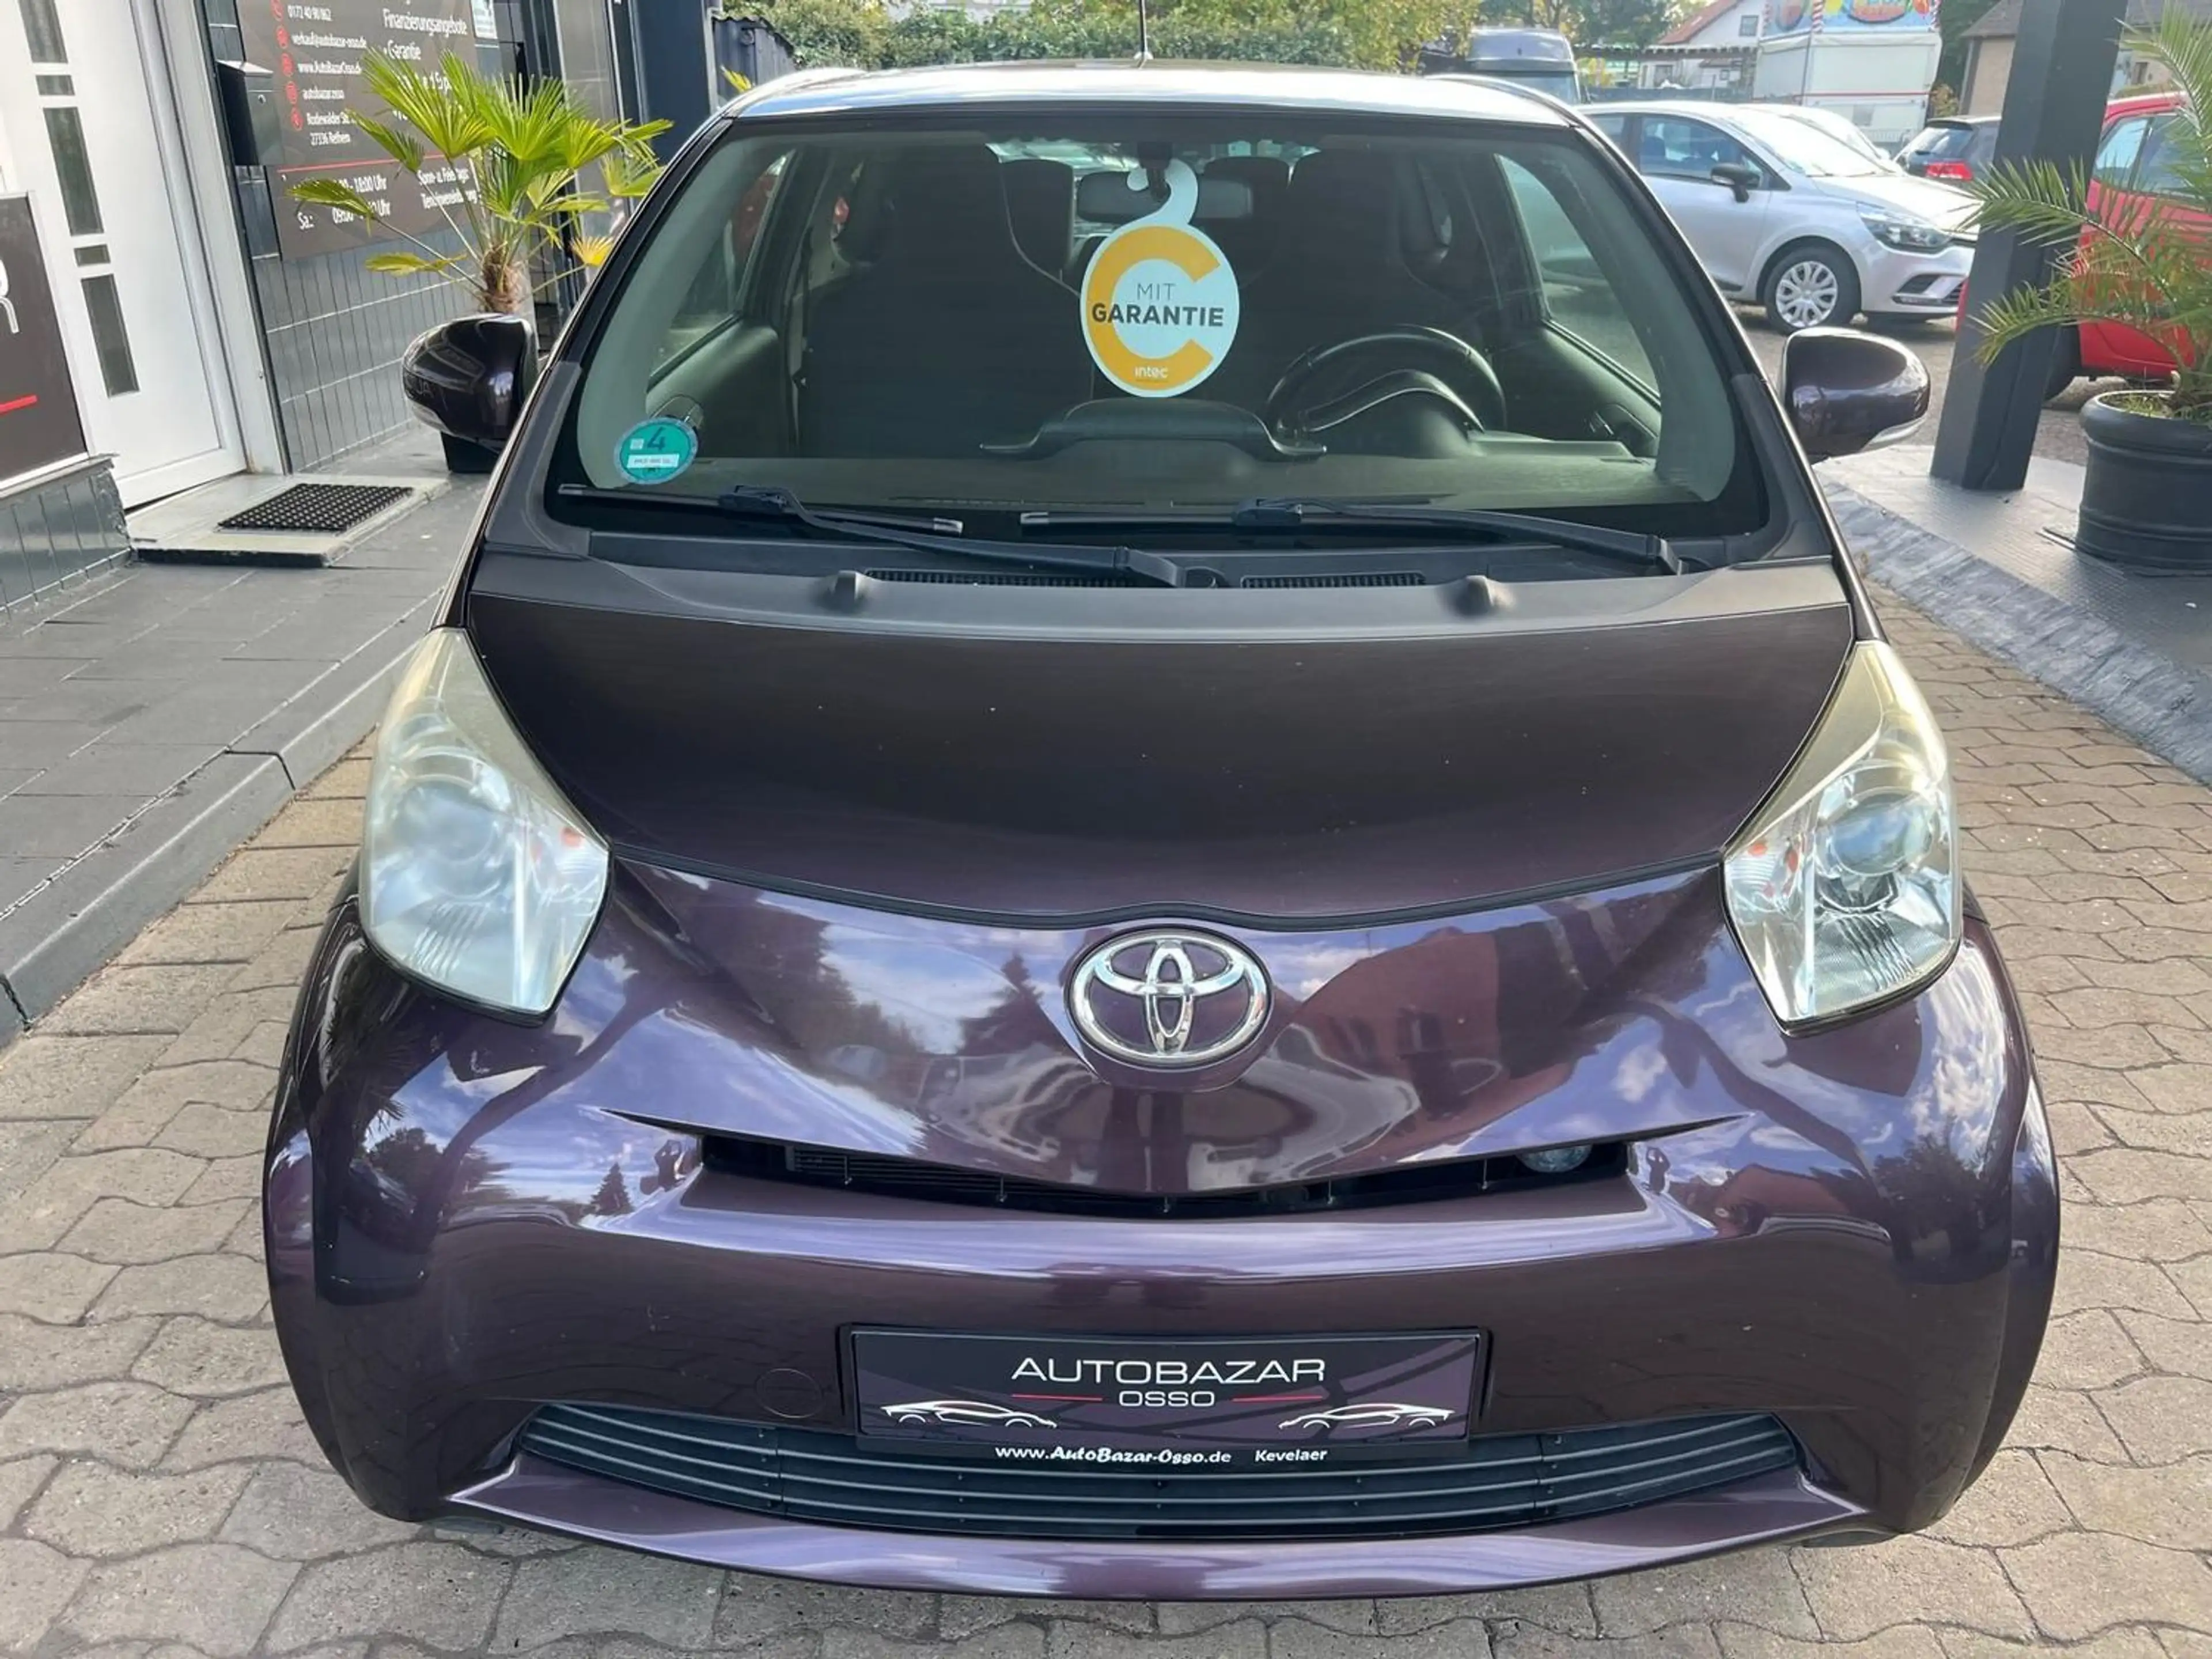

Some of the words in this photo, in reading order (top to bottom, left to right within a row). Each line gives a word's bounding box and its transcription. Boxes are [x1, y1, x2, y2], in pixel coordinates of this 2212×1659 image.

[382, 8, 468, 38] Finanzierungsangebote
[388, 40, 421, 60] Garantie
[374, 174, 387, 191] Uhr
[377, 199, 391, 217] Uhr
[1137, 283, 1176, 300] MIT
[1092, 303, 1224, 327] GARANTIE
[1134, 366, 1169, 378] intec
[647, 426, 666, 450] 4
[1012, 1358, 1325, 1384] AUTOBAZAR
[1119, 1391, 1215, 1407] OSSO
[995, 1446, 1232, 1465] www.AutoBazar-Osso.de
[1255, 1449, 1328, 1463] Kevelaer
